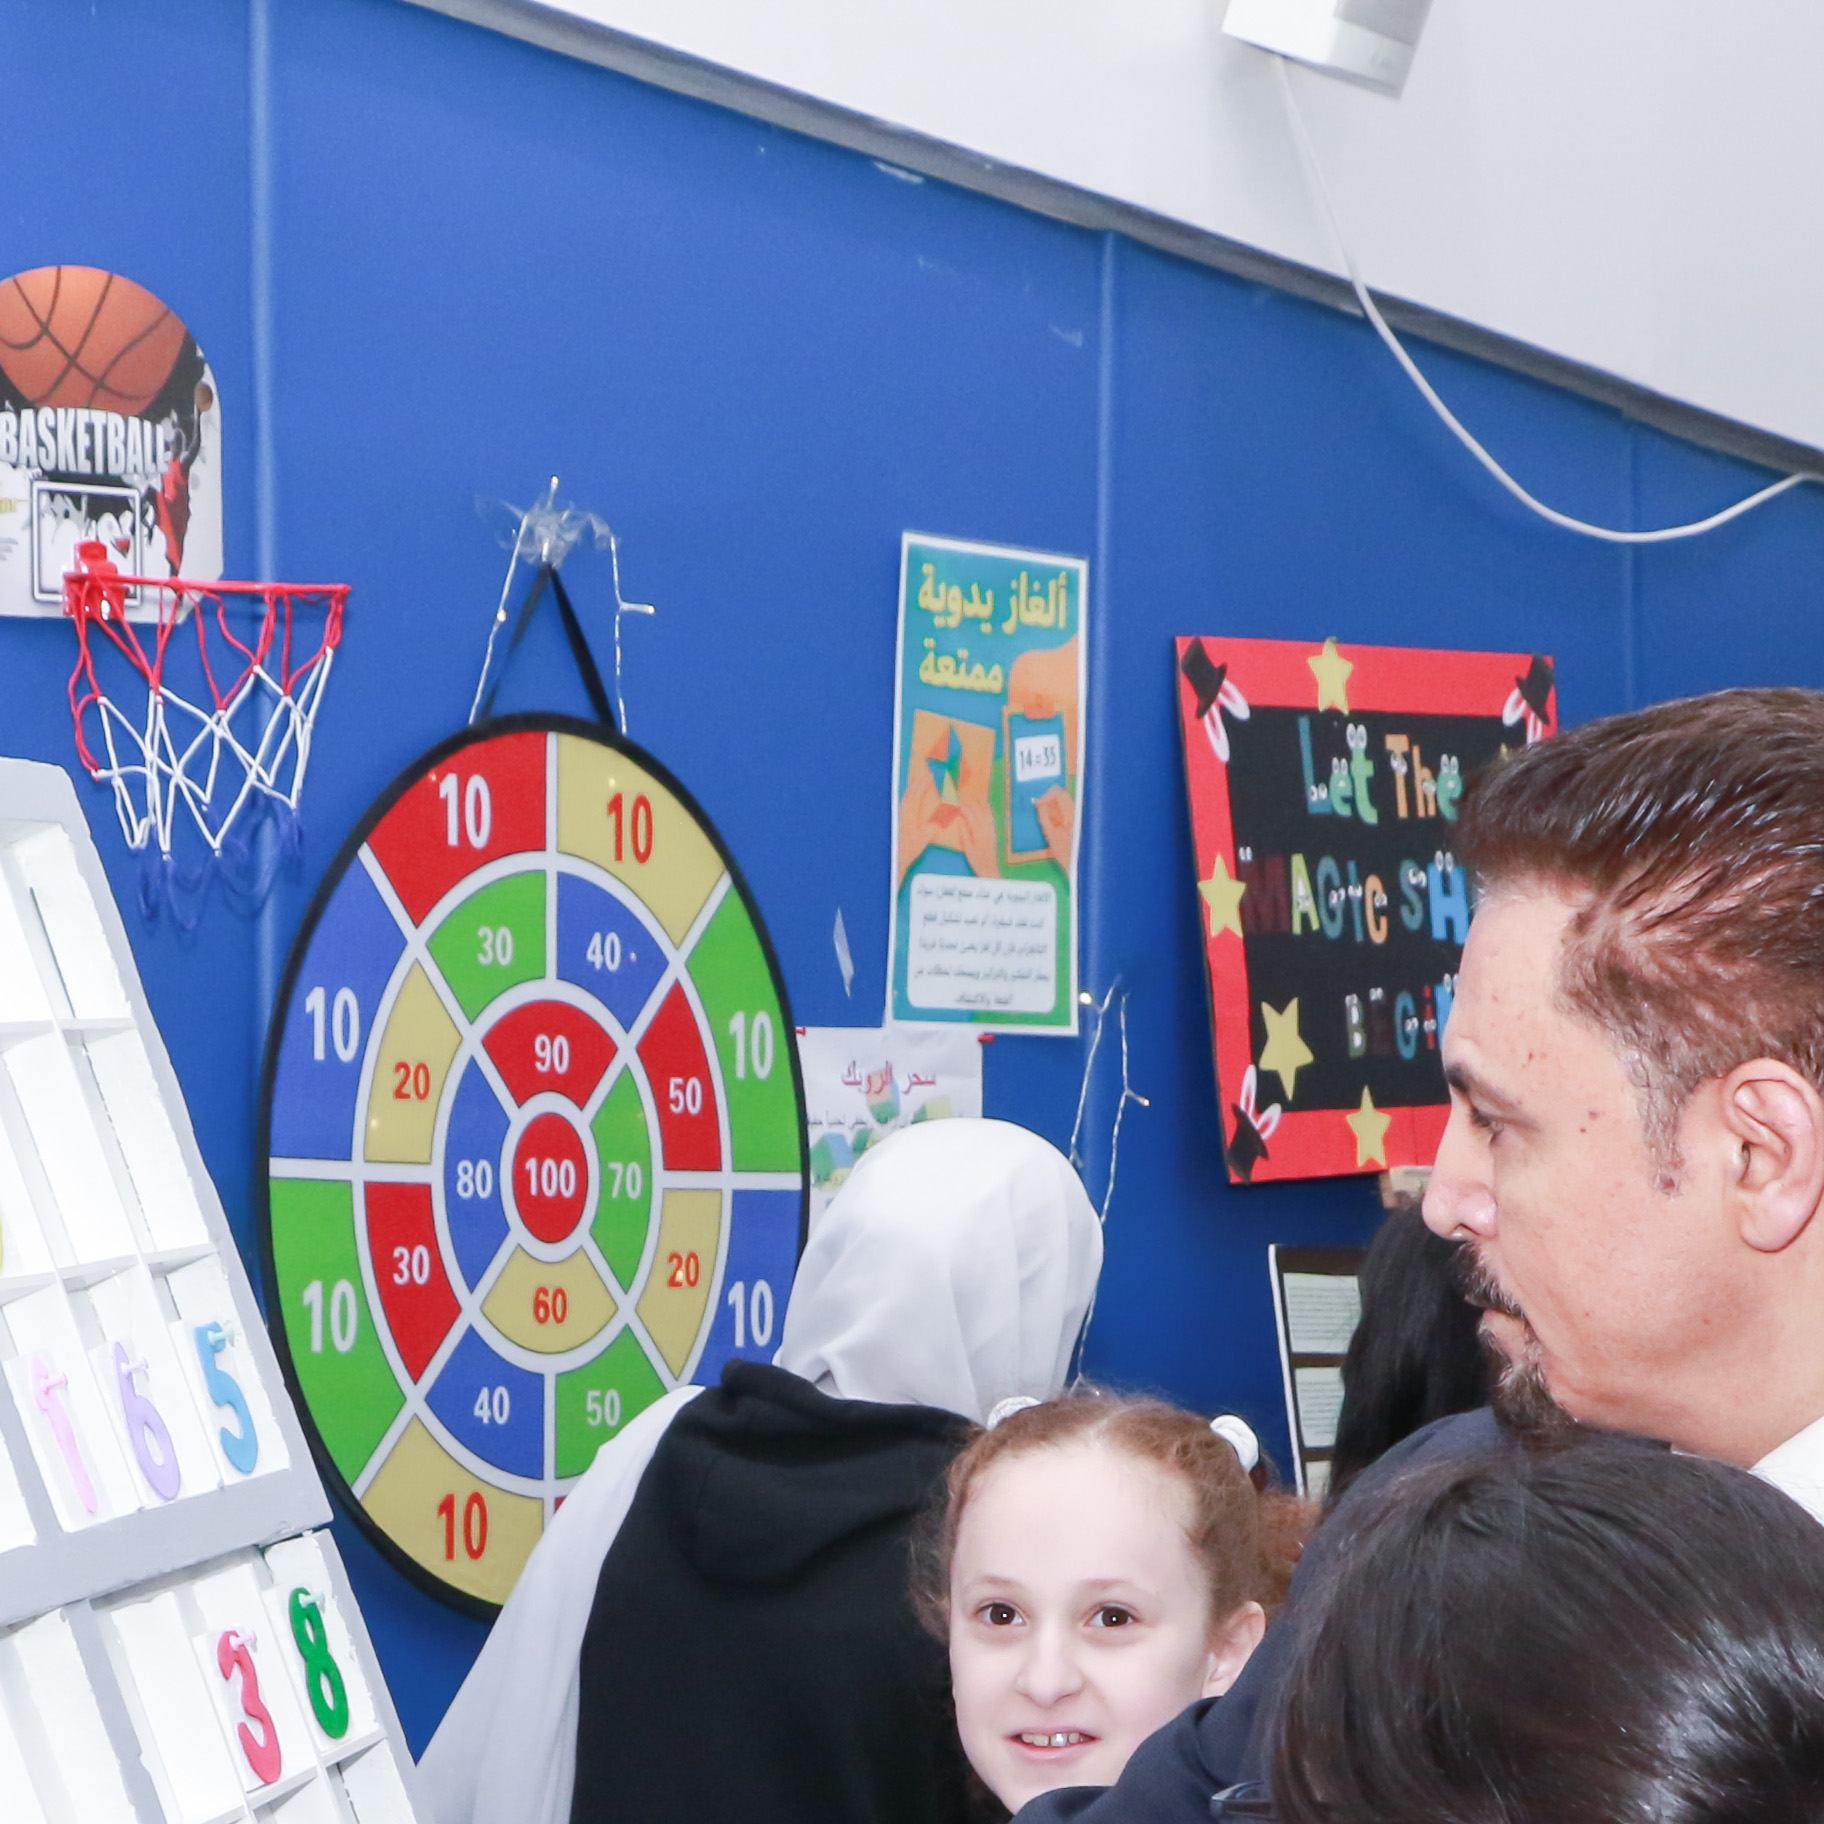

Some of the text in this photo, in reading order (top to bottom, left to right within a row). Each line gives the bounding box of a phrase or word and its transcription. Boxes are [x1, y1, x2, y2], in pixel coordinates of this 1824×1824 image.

[917, 562, 1068, 635] ألغاز يدوية
[918, 637, 1005, 694] ممتعة
[1297, 715, 1463, 824] Let The
[438, 773, 493, 850] 10
[606, 792, 655, 865] 10
[476, 925, 515, 968] 30
[585, 931, 623, 972] 40
[304, 986, 361, 1065] 10
[728, 1010, 775, 1080] 10
[533, 1032, 571, 1075] 90
[392, 1061, 432, 1101] 20
[667, 1076, 704, 1116] 50
[455, 1158, 494, 1200] 80
[523, 1156, 577, 1199] 100
[607, 1162, 643, 1201] 70
[391, 1245, 431, 1287] 30
[666, 1250, 701, 1291] 20
[302, 1278, 358, 1355] 10
[531, 1285, 569, 1326] 60
[727, 1279, 775, 1350] 10
[31, 1357, 98, 1515] 1
[113, 1340, 182, 1501] 6
[194, 1321, 259, 1476] 5
[471, 1384, 511, 1426] 40
[584, 1388, 622, 1429] 50
[437, 1491, 489, 1562] 10
[216, 1629, 282, 1785] 3
[289, 1586, 350, 1740] 8
